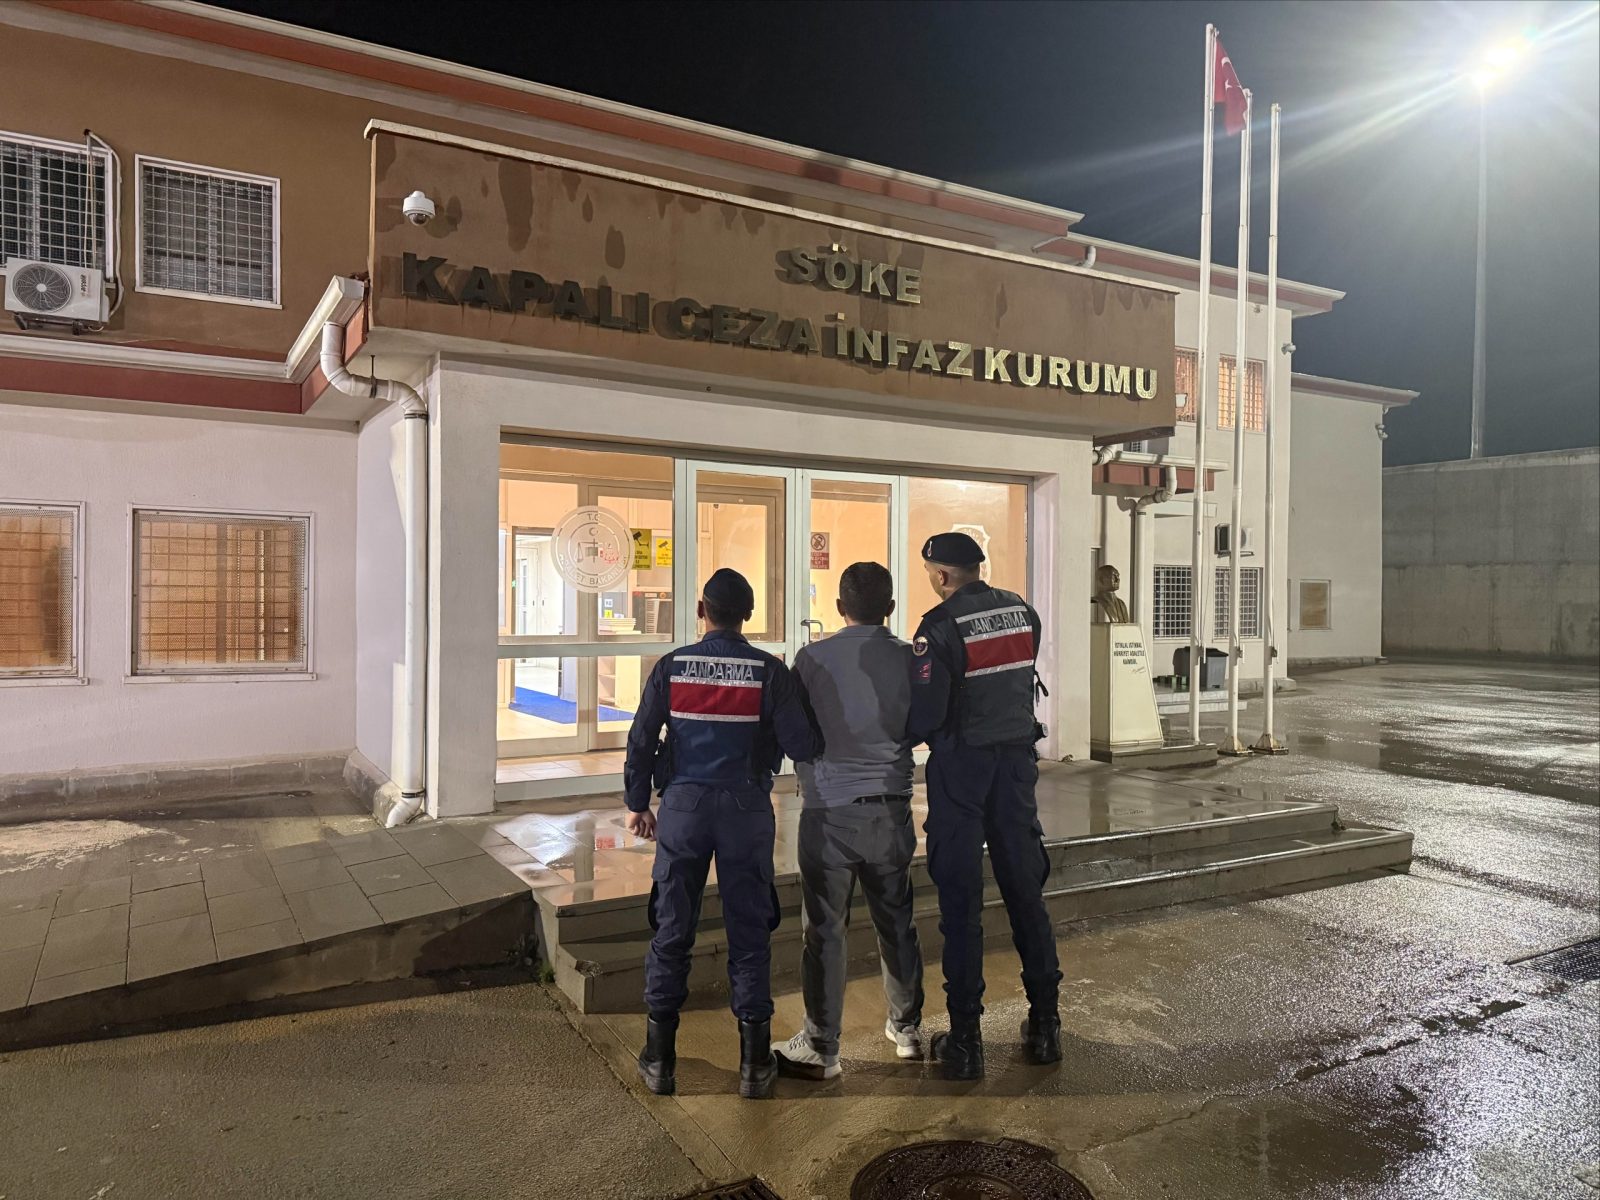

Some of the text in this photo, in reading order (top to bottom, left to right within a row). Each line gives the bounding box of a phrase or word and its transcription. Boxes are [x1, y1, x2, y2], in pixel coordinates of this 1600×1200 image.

[790, 242, 921, 304] SÖKE
[401, 252, 1158, 400] KAPALI CEZA İNFAZ KURUMU
[969, 611, 1027, 635] JANDARMA
[681, 661, 754, 681] JANDARMA
